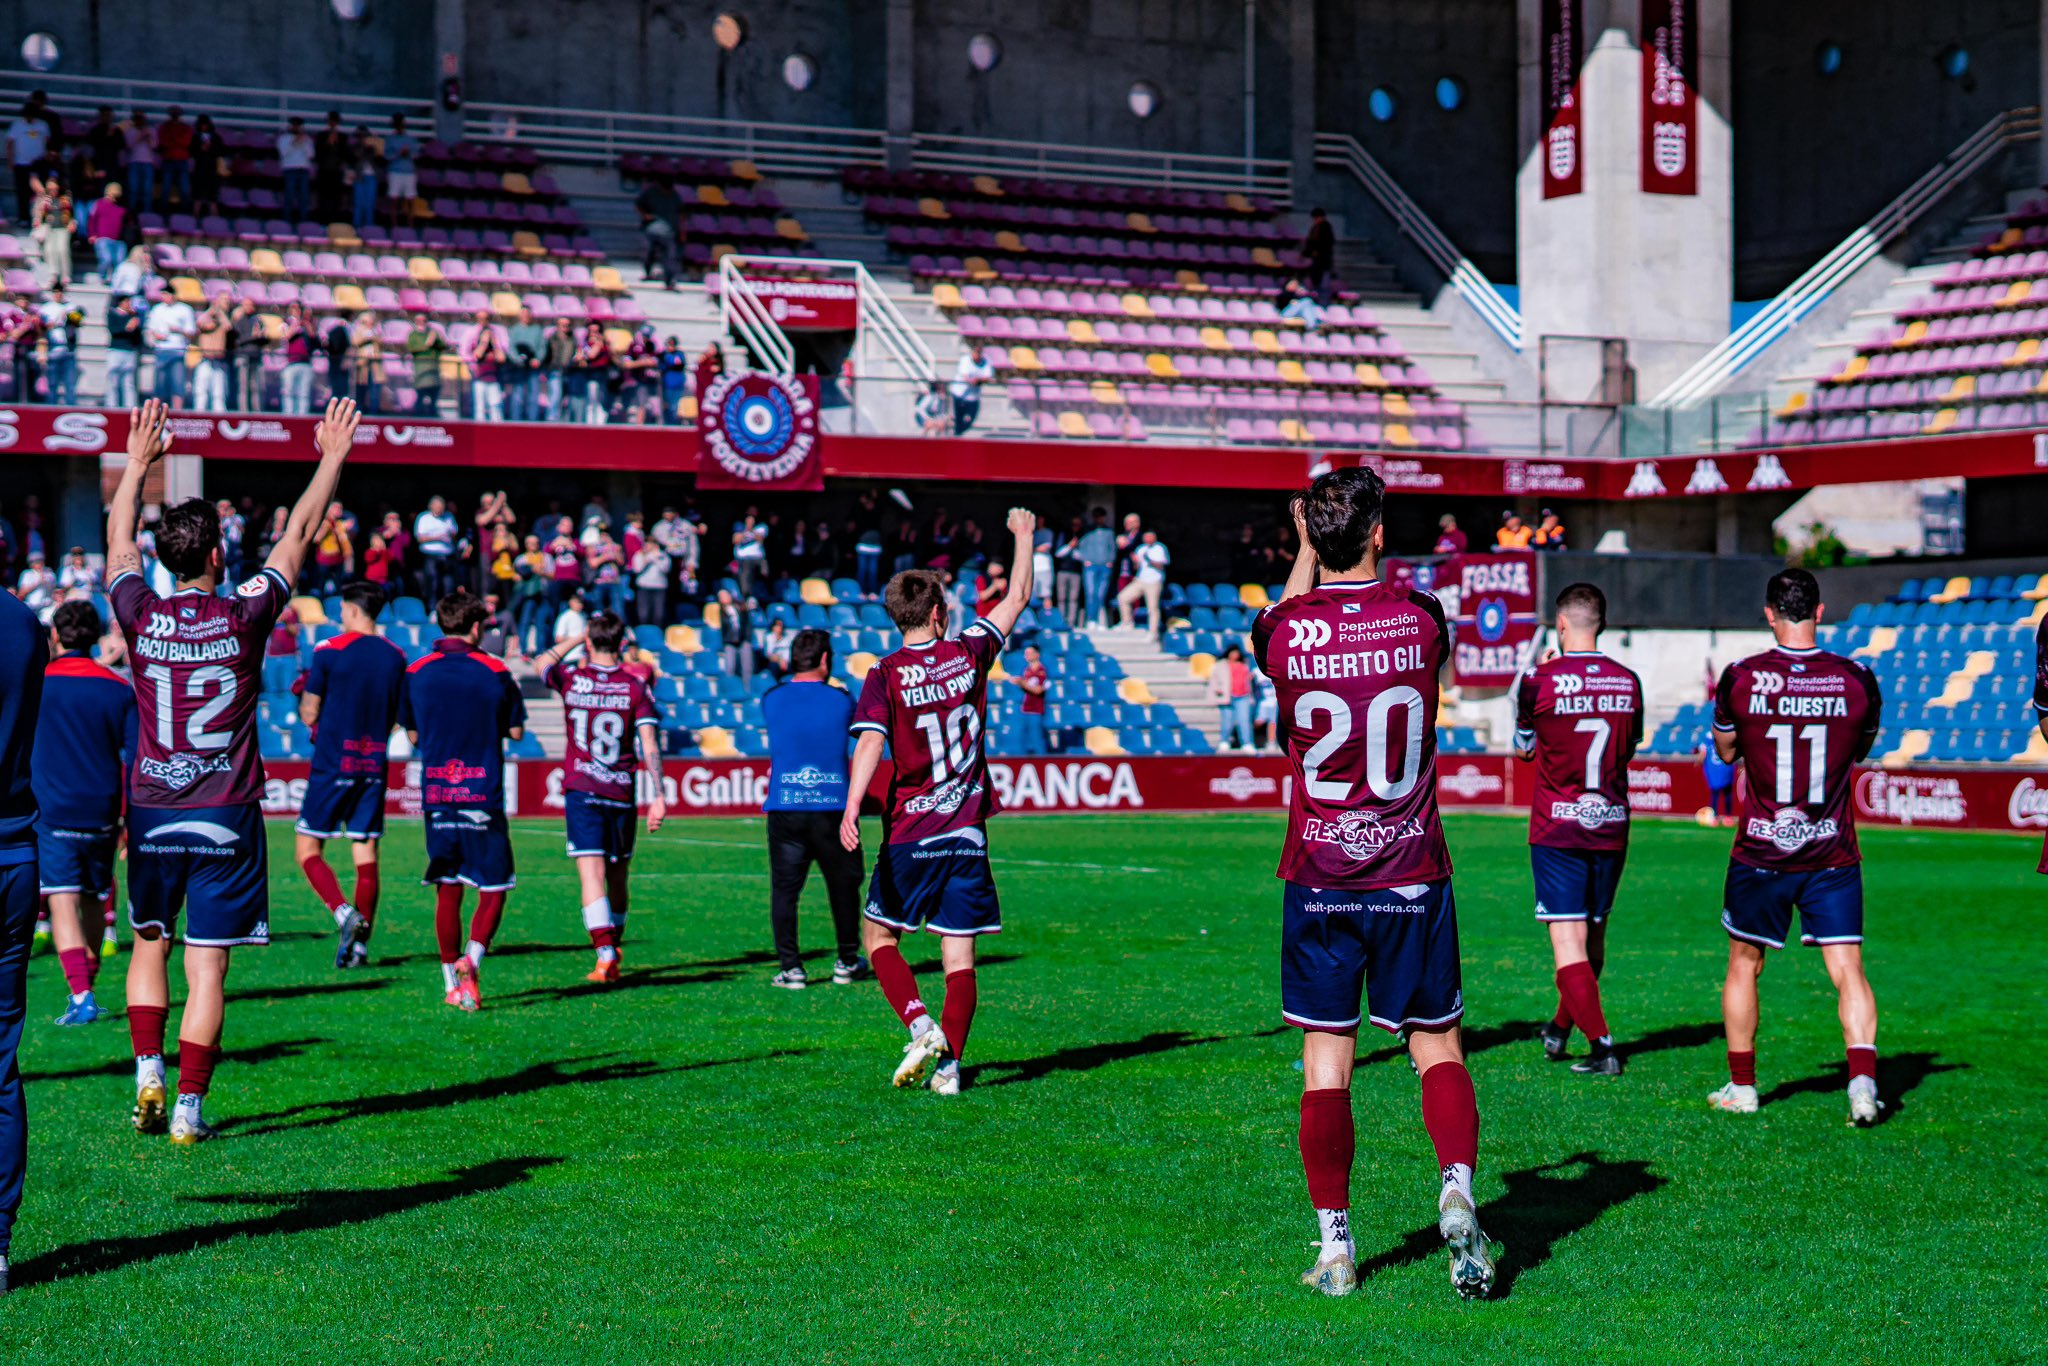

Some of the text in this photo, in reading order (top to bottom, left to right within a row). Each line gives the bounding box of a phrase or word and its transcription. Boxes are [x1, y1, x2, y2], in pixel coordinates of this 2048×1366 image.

[1461, 561, 1531, 598] FOSSA
[177, 615, 229, 633] Deputación
[1339, 612, 1418, 634] Deputación
[1339, 625, 1419, 644] Pontevedra
[168, 635, 241, 662] BALLARDO
[1287, 644, 1425, 680] ALBERTO GIL
[1787, 675, 1846, 686] Deputación
[1787, 683, 1846, 692] Pontevedra
[144, 663, 238, 750] 12
[599, 694, 632, 711] LOPEZ
[900, 684, 947, 708] YELKO
[1554, 694, 1635, 715] ALEX GLEZ.
[1748, 693, 1849, 717] M. CUESTA
[568, 708, 625, 766] 18
[915, 703, 981, 784] 10
[1294, 685, 1424, 800] 20
[1573, 718, 1611, 790] 7
[1764, 723, 1828, 804] 11
[1551, 801, 1628, 822] PESCAMAR
[1302, 815, 1425, 849] PESCAMAR
[1746, 817, 1839, 840] PESCAMAR
[1304, 901, 1425, 914] visit-ponte vedra.com
